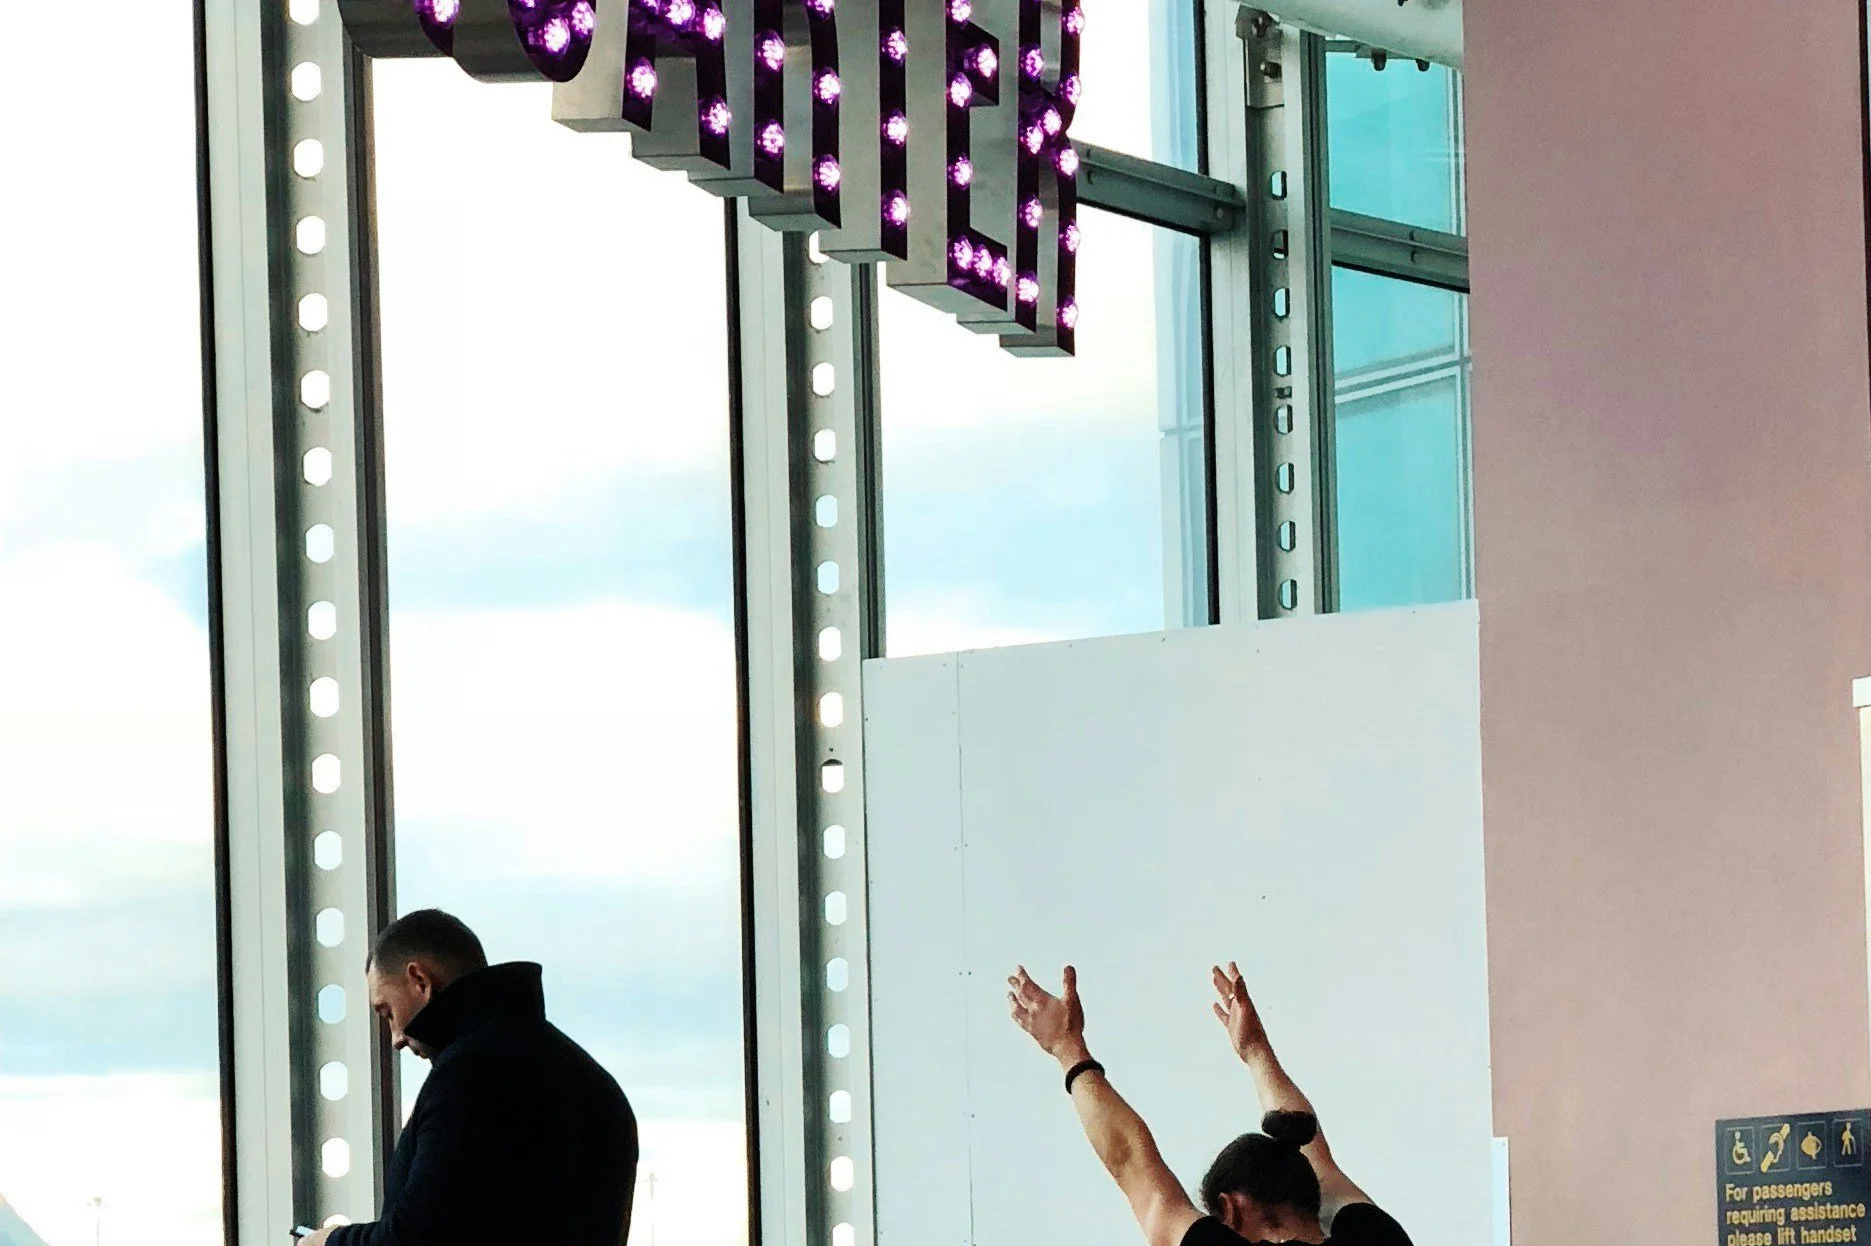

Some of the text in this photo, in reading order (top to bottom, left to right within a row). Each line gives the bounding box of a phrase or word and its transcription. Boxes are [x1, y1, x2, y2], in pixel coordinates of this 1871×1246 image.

[1725, 1180, 1833, 1203] For passengers
[1726, 1202, 1866, 1227] requiring assistance
[1777, 1226, 1796, 1245] lift
[1801, 1224, 1857, 1244] handset
